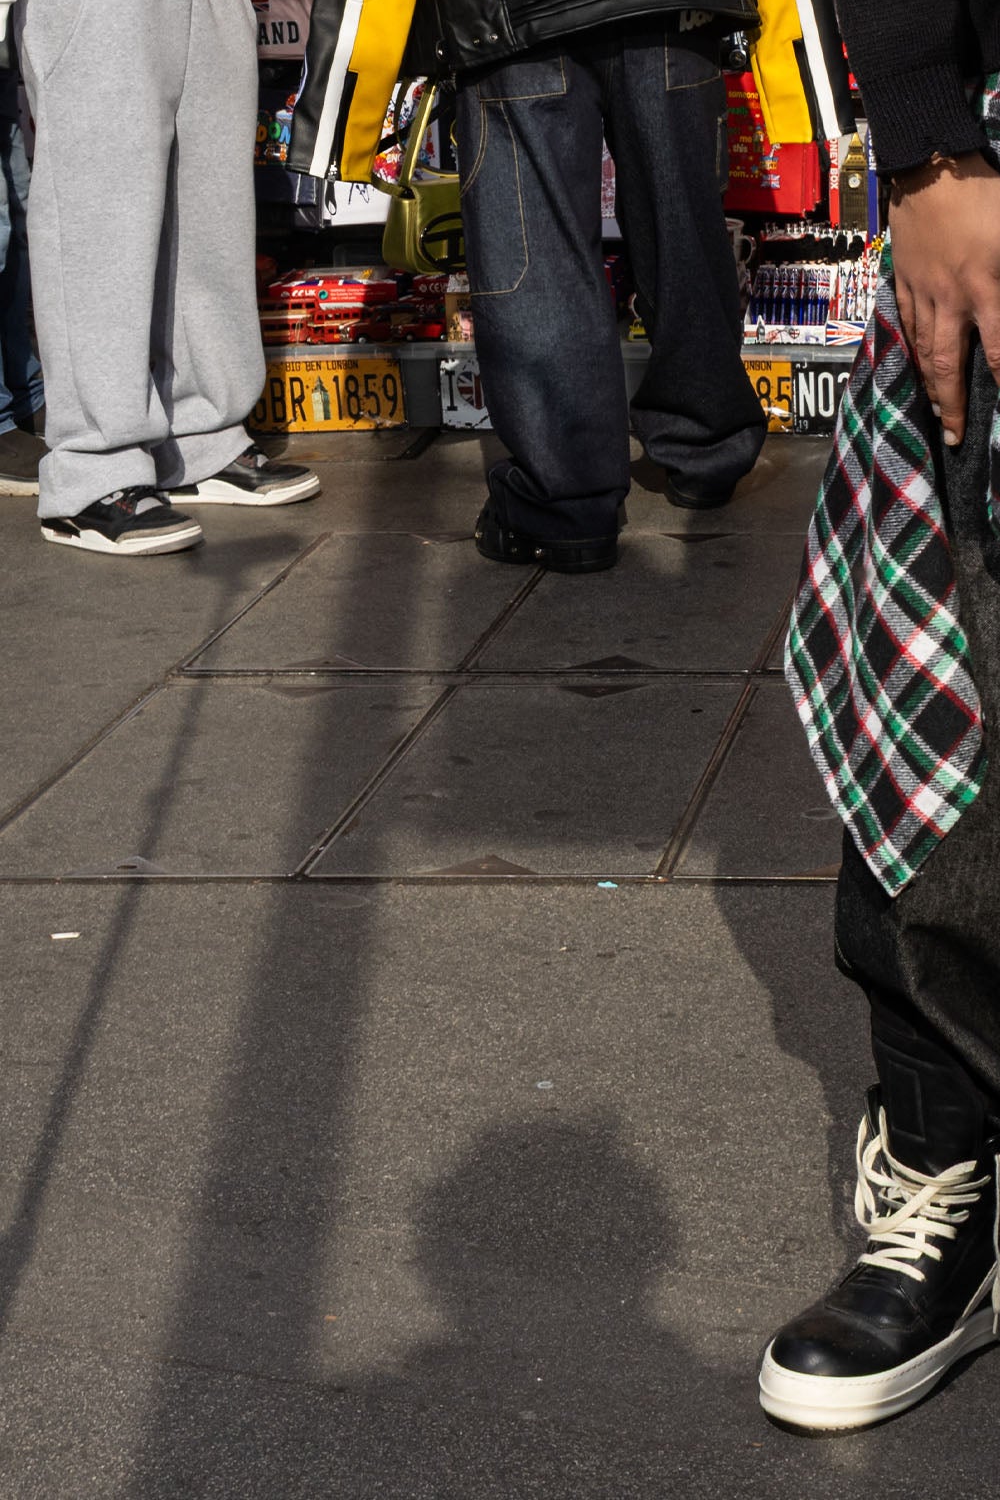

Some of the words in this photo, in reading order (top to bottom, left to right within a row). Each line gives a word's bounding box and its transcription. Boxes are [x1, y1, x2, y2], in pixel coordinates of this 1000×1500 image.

[728, 91, 759, 100] someone
[830, 137, 839, 166] ONEY
[830, 169, 839, 190] BOX
[285, 361, 301, 371] BIG
[305, 360, 322, 371] BEN
[333, 373, 398, 421] 1859
